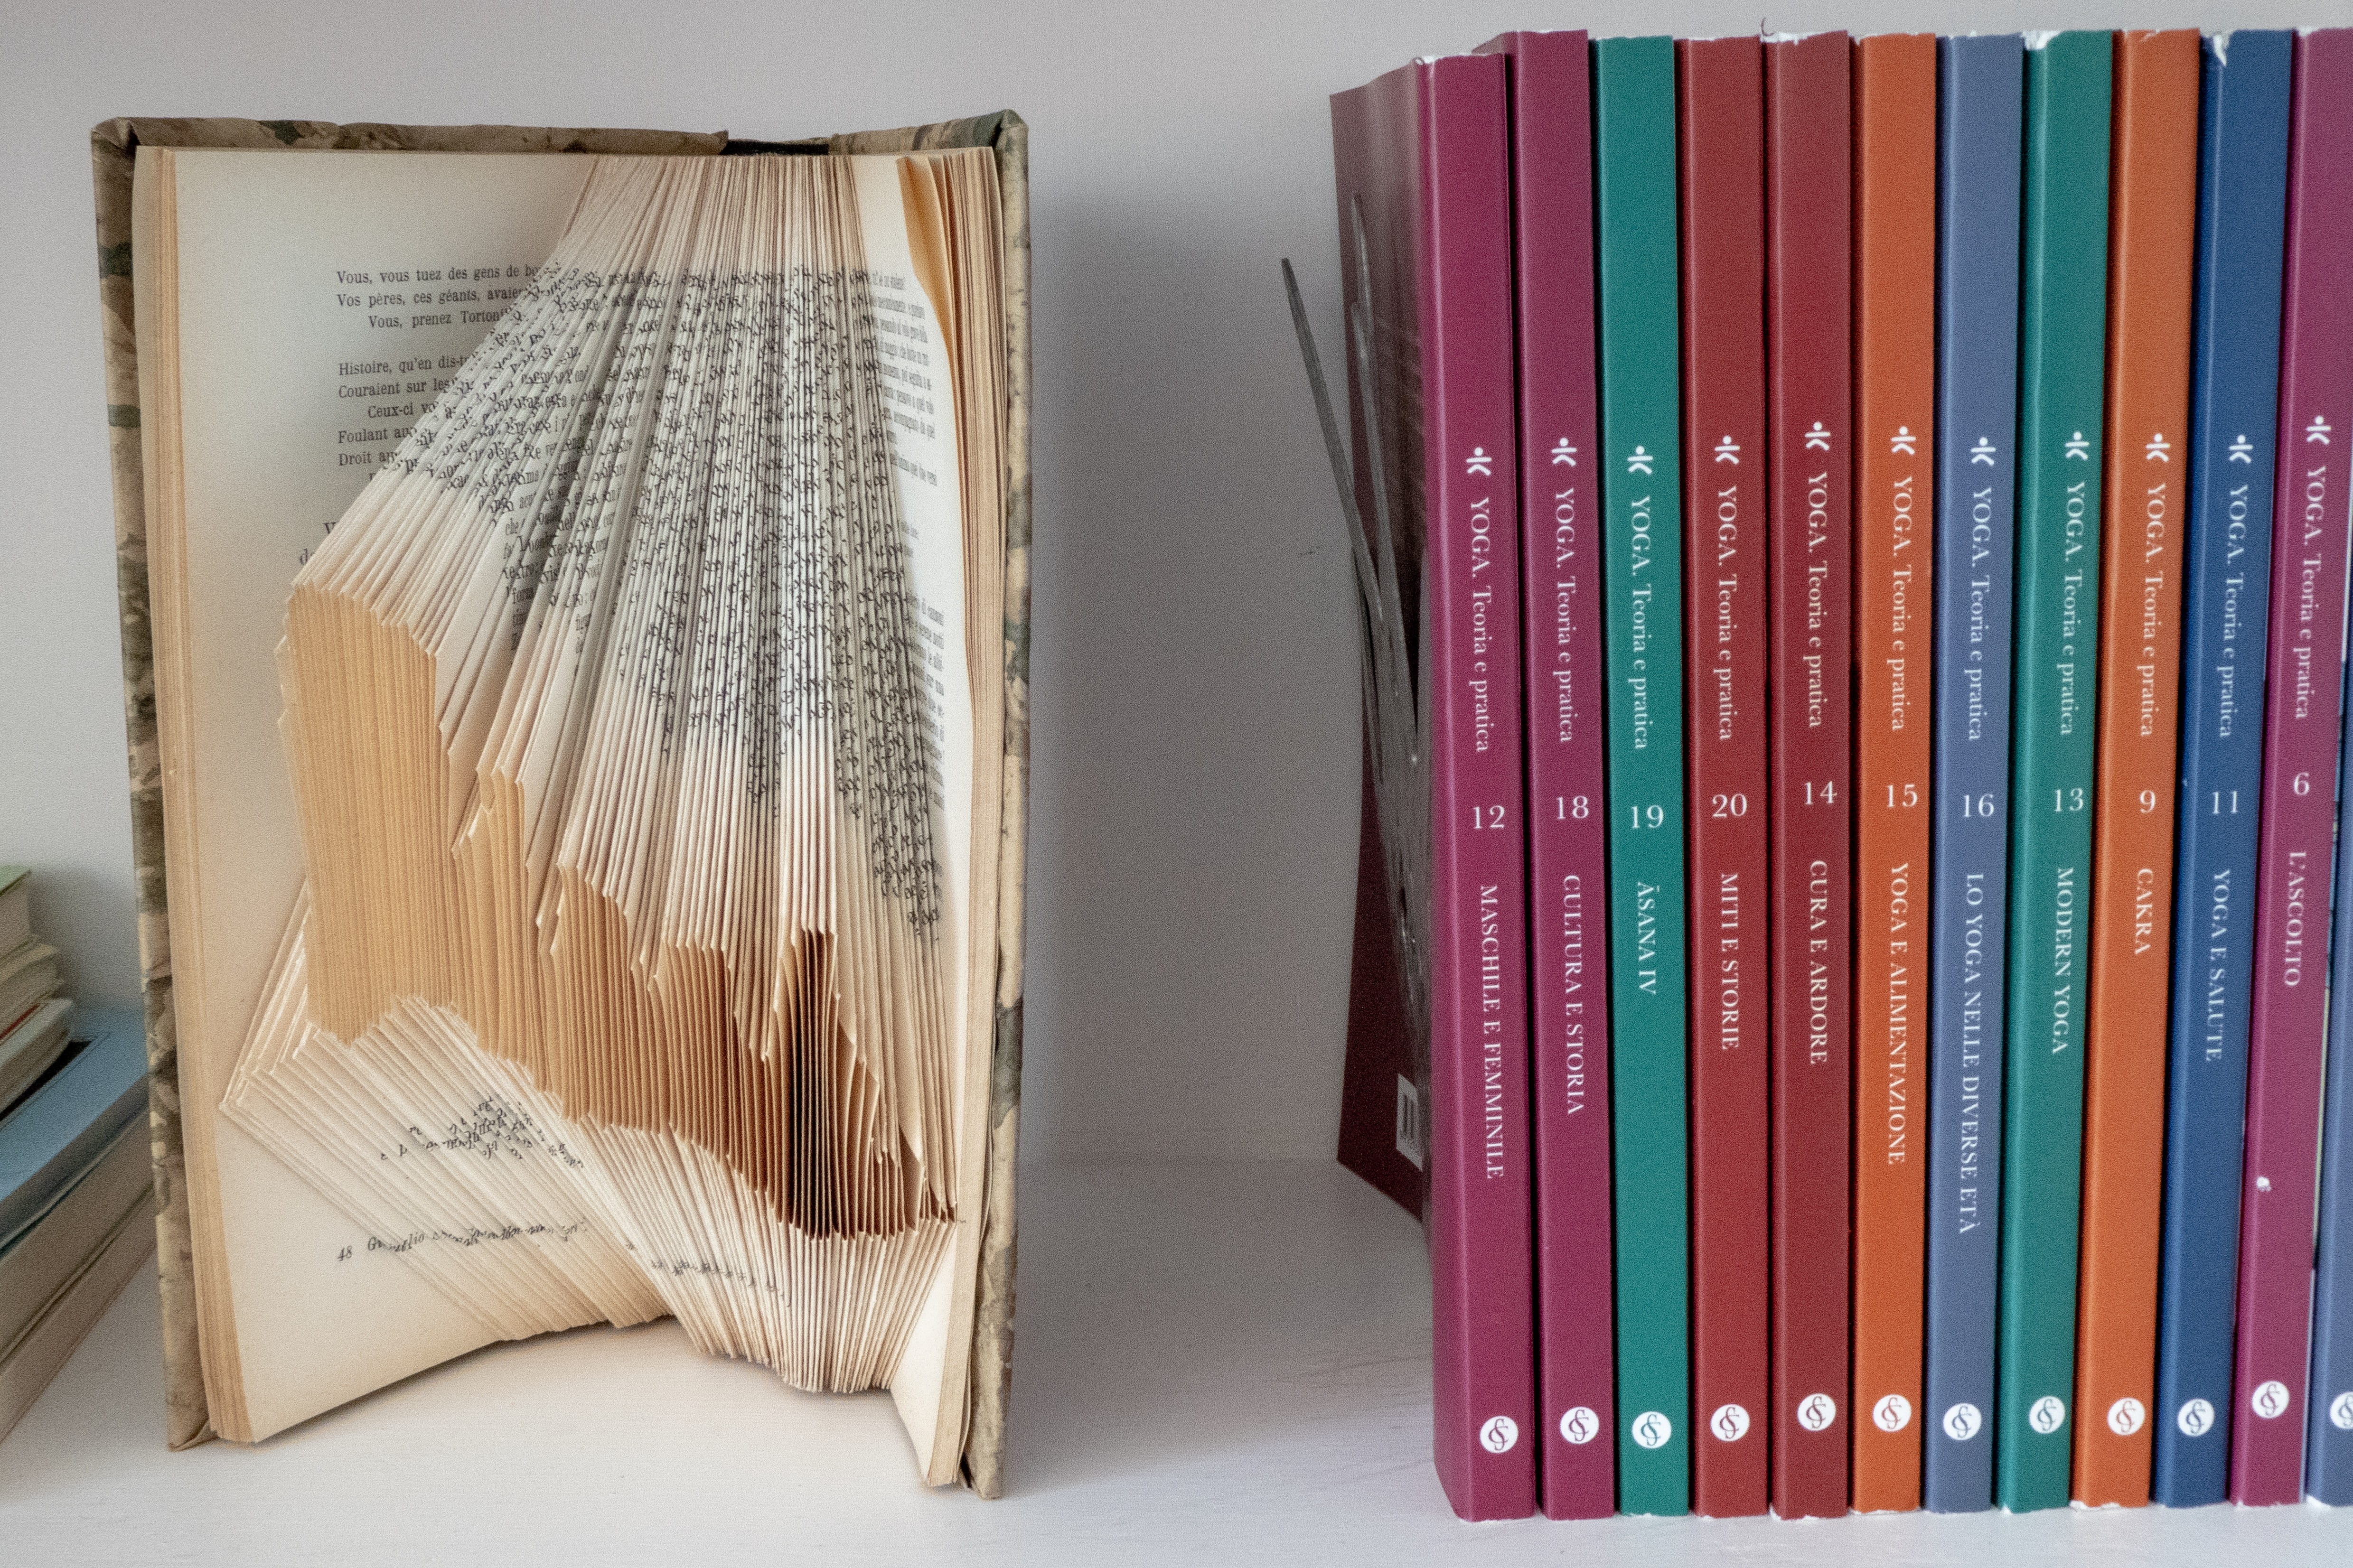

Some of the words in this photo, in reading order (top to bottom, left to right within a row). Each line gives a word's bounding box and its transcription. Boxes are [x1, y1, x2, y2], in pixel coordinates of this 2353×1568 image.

[337, 271, 372, 284] Vous,
[380, 271, 409, 282] vous
[416, 269, 441, 281] tuez
[448, 267, 468, 280] des
[474, 267, 500, 281] gens
[506, 264, 519, 277] de
[337, 294, 361, 307] Vos
[368, 292, 406, 308] pères,
[413, 292, 432, 304] ces
[439, 289, 480, 304] géants,
[368, 315, 403, 328] Vous,
[412, 314, 451, 328] prenez
[338, 382, 400, 398] Couraient
[406, 381, 426, 393] sur
[339, 360, 392, 375] Histoire,
[399, 357, 431, 373] qu'en
[338, 428, 388, 443] Foulant
[368, 402, 413, 418] Ceux-ci
[338, 451, 372, 466] Droit
[1470, 496, 1491, 578] YOGA.
[1555, 487, 1575, 569] YOGA.
[1631, 495, 1651, 577] YOGA.
[1717, 485, 1737, 567] YOGA.
[1808, 471, 1828, 553] YOGA.
[1893, 476, 1913, 557] YOGA.
[1971, 486, 1992, 568] YOGA.
[2064, 481, 2085, 562] YOGA.
[2145, 483, 2166, 563] YOGA.
[2226, 484, 2249, 565] YOGA.
[2303, 465, 2326, 546] YOGA.
[1472, 585, 1493, 655] Teoria
[1556, 575, 1577, 645] Teoria
[1631, 583, 1652, 653] Teoria
[1718, 573, 1738, 644] Teoria
[1808, 560, 1828, 630] Teoria
[1892, 564, 1912, 633] Teoria
[1970, 574, 1990, 644] Teoria
[2062, 569, 2083, 638] Teoria
[2143, 570, 2164, 640] Teoria
[2223, 571, 2244, 641] Teoria
[2300, 552, 2322, 622] Teoria
[1474, 661, 1487, 672] e
[1558, 651, 1571, 663] e
[1633, 659, 1646, 671] e
[1718, 649, 1732, 661] e
[1808, 636, 1822, 648] e
[1892, 639, 1905, 652] e
[1969, 650, 1983, 662] e
[2062, 644, 2075, 656] e
[2143, 645, 2155, 658] e
[2223, 647, 2235, 659] e
[2299, 628, 2312, 640] e
[1468, 679, 1495, 753] pratica
[1552, 669, 1579, 743] pratica
[1627, 677, 1654, 750] pratica
[1712, 667, 1738, 741] pratica
[1802, 654, 1828, 728] pratica
[1886, 657, 1911, 731] pratica
[1963, 668, 1988, 741] pratica
[2056, 662, 2080, 736] pratica
[2136, 664, 2160, 737] pratica
[2216, 665, 2239, 738] pratica
[2292, 646, 2316, 719] pratica
[1473, 804, 1506, 830] 12
[1556, 795, 1590, 820] 18
[1631, 804, 1664, 829] 19
[1712, 793, 1748, 818] 20
[1805, 780, 1837, 805] 14
[1887, 783, 1919, 808] 15
[1963, 793, 1995, 818] 16
[2054, 787, 2084, 813] 13
[2139, 790, 2156, 813] 9
[2212, 790, 2238, 815] 11
[2293, 772, 2310, 796] 6
[1721, 873, 1739, 929] MITI
[1809, 859, 1828, 931] CURA
[1890, 862, 1909, 933] YOGA
[1966, 873, 1984, 906] LO
[2054, 867, 2074, 977] MODERN
[2134, 868, 2153, 955] CAKRA
[2211, 869, 2231, 939] YOGA
[1480, 885, 1500, 1013] MASCHILE
[1563, 874, 1583, 994] CULTURA
[1721, 938, 1739, 952] E
[1809, 938, 1828, 953] E
[1890, 941, 1908, 955] E
[1964, 914, 1983, 984] YOGA
[2210, 947, 2227, 961] E
[1565, 1002, 1583, 1016] E
[1638, 970, 1657, 995] IV
[1721, 960, 1739, 1050] STORIE
[1809, 961, 1828, 1065] ARDORE
[2205, 968, 2225, 1062] SALUTE
[1483, 1020, 1501, 1035] E
[1962, 991, 1982, 1068] NELLE
[2052, 984, 2071, 1055] YOGA
[1566, 1023, 1585, 1115] STORIA
[1888, 962, 1908, 1165] ALIMENTAZIONE
[1483, 1042, 1504, 1179] FEMMINILE
[1960, 1076, 1980, 1180] DIVERSE
[1959, 1187, 1980, 1234] ETÀ
